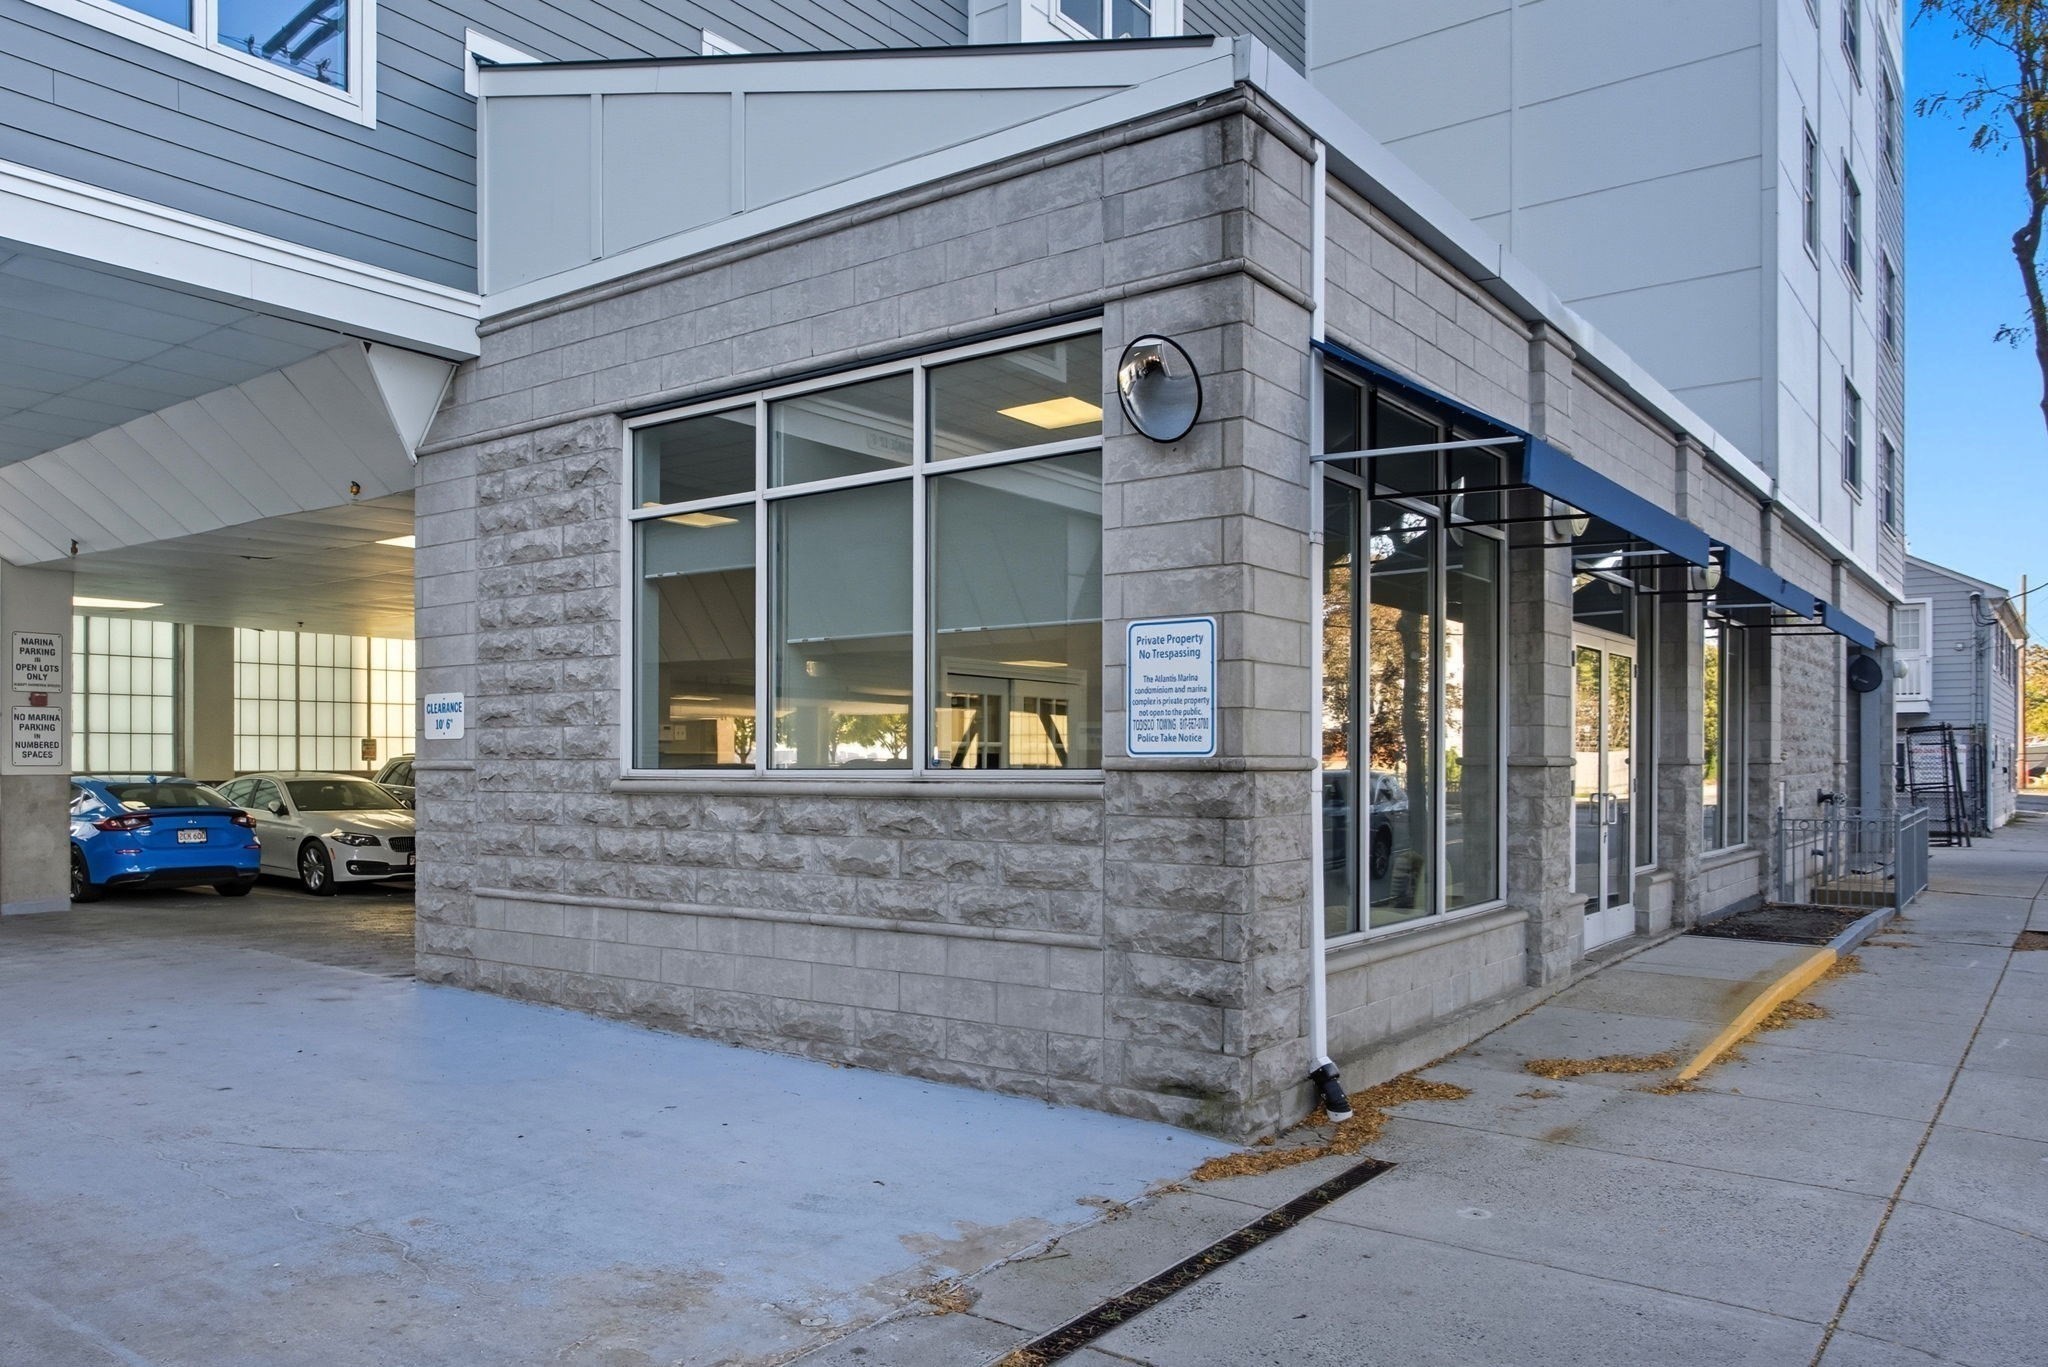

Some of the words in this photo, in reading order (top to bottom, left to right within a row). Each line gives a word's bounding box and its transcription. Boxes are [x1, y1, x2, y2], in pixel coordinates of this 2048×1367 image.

[21, 637, 54, 646] MARINA
[1136, 635, 1165, 646] Private
[1167, 633, 1204, 646] Property
[19, 647, 56, 656] PARKING
[1139, 649, 1151, 660] No
[1152, 647, 1201, 660] Trespassing
[15, 663, 37, 671] OPEN
[40, 664, 60, 672] LOTS
[26, 672, 48, 681] ONLY
[1143, 675, 1154, 683] The
[1155, 674, 1177, 683] Atlantis
[1178, 674, 1199, 682] Marina
[1175, 685, 1186, 694] and
[1187, 685, 1207, 693] marina
[1132, 698, 1156, 707] complex
[1156, 697, 1162, 705] is
[1162, 697, 1183, 706] private
[1183, 697, 1210, 706] property
[426, 701, 463, 714] CLEARANCE
[13, 713, 26, 721] NO
[27, 713, 61, 722] MARINA
[1138, 709, 1149, 717] not
[1149, 709, 1165, 718] open
[1171, 708, 1182, 716] the
[19, 723, 56, 732] PARKING
[1156, 718, 1177, 730] TOWING
[1137, 732, 1159, 743] Police
[1160, 733, 1177, 742] Take
[1178, 732, 1203, 742] Notice
[15, 741, 60, 749] NUMBERED
[22, 751, 54, 759] SPACES
